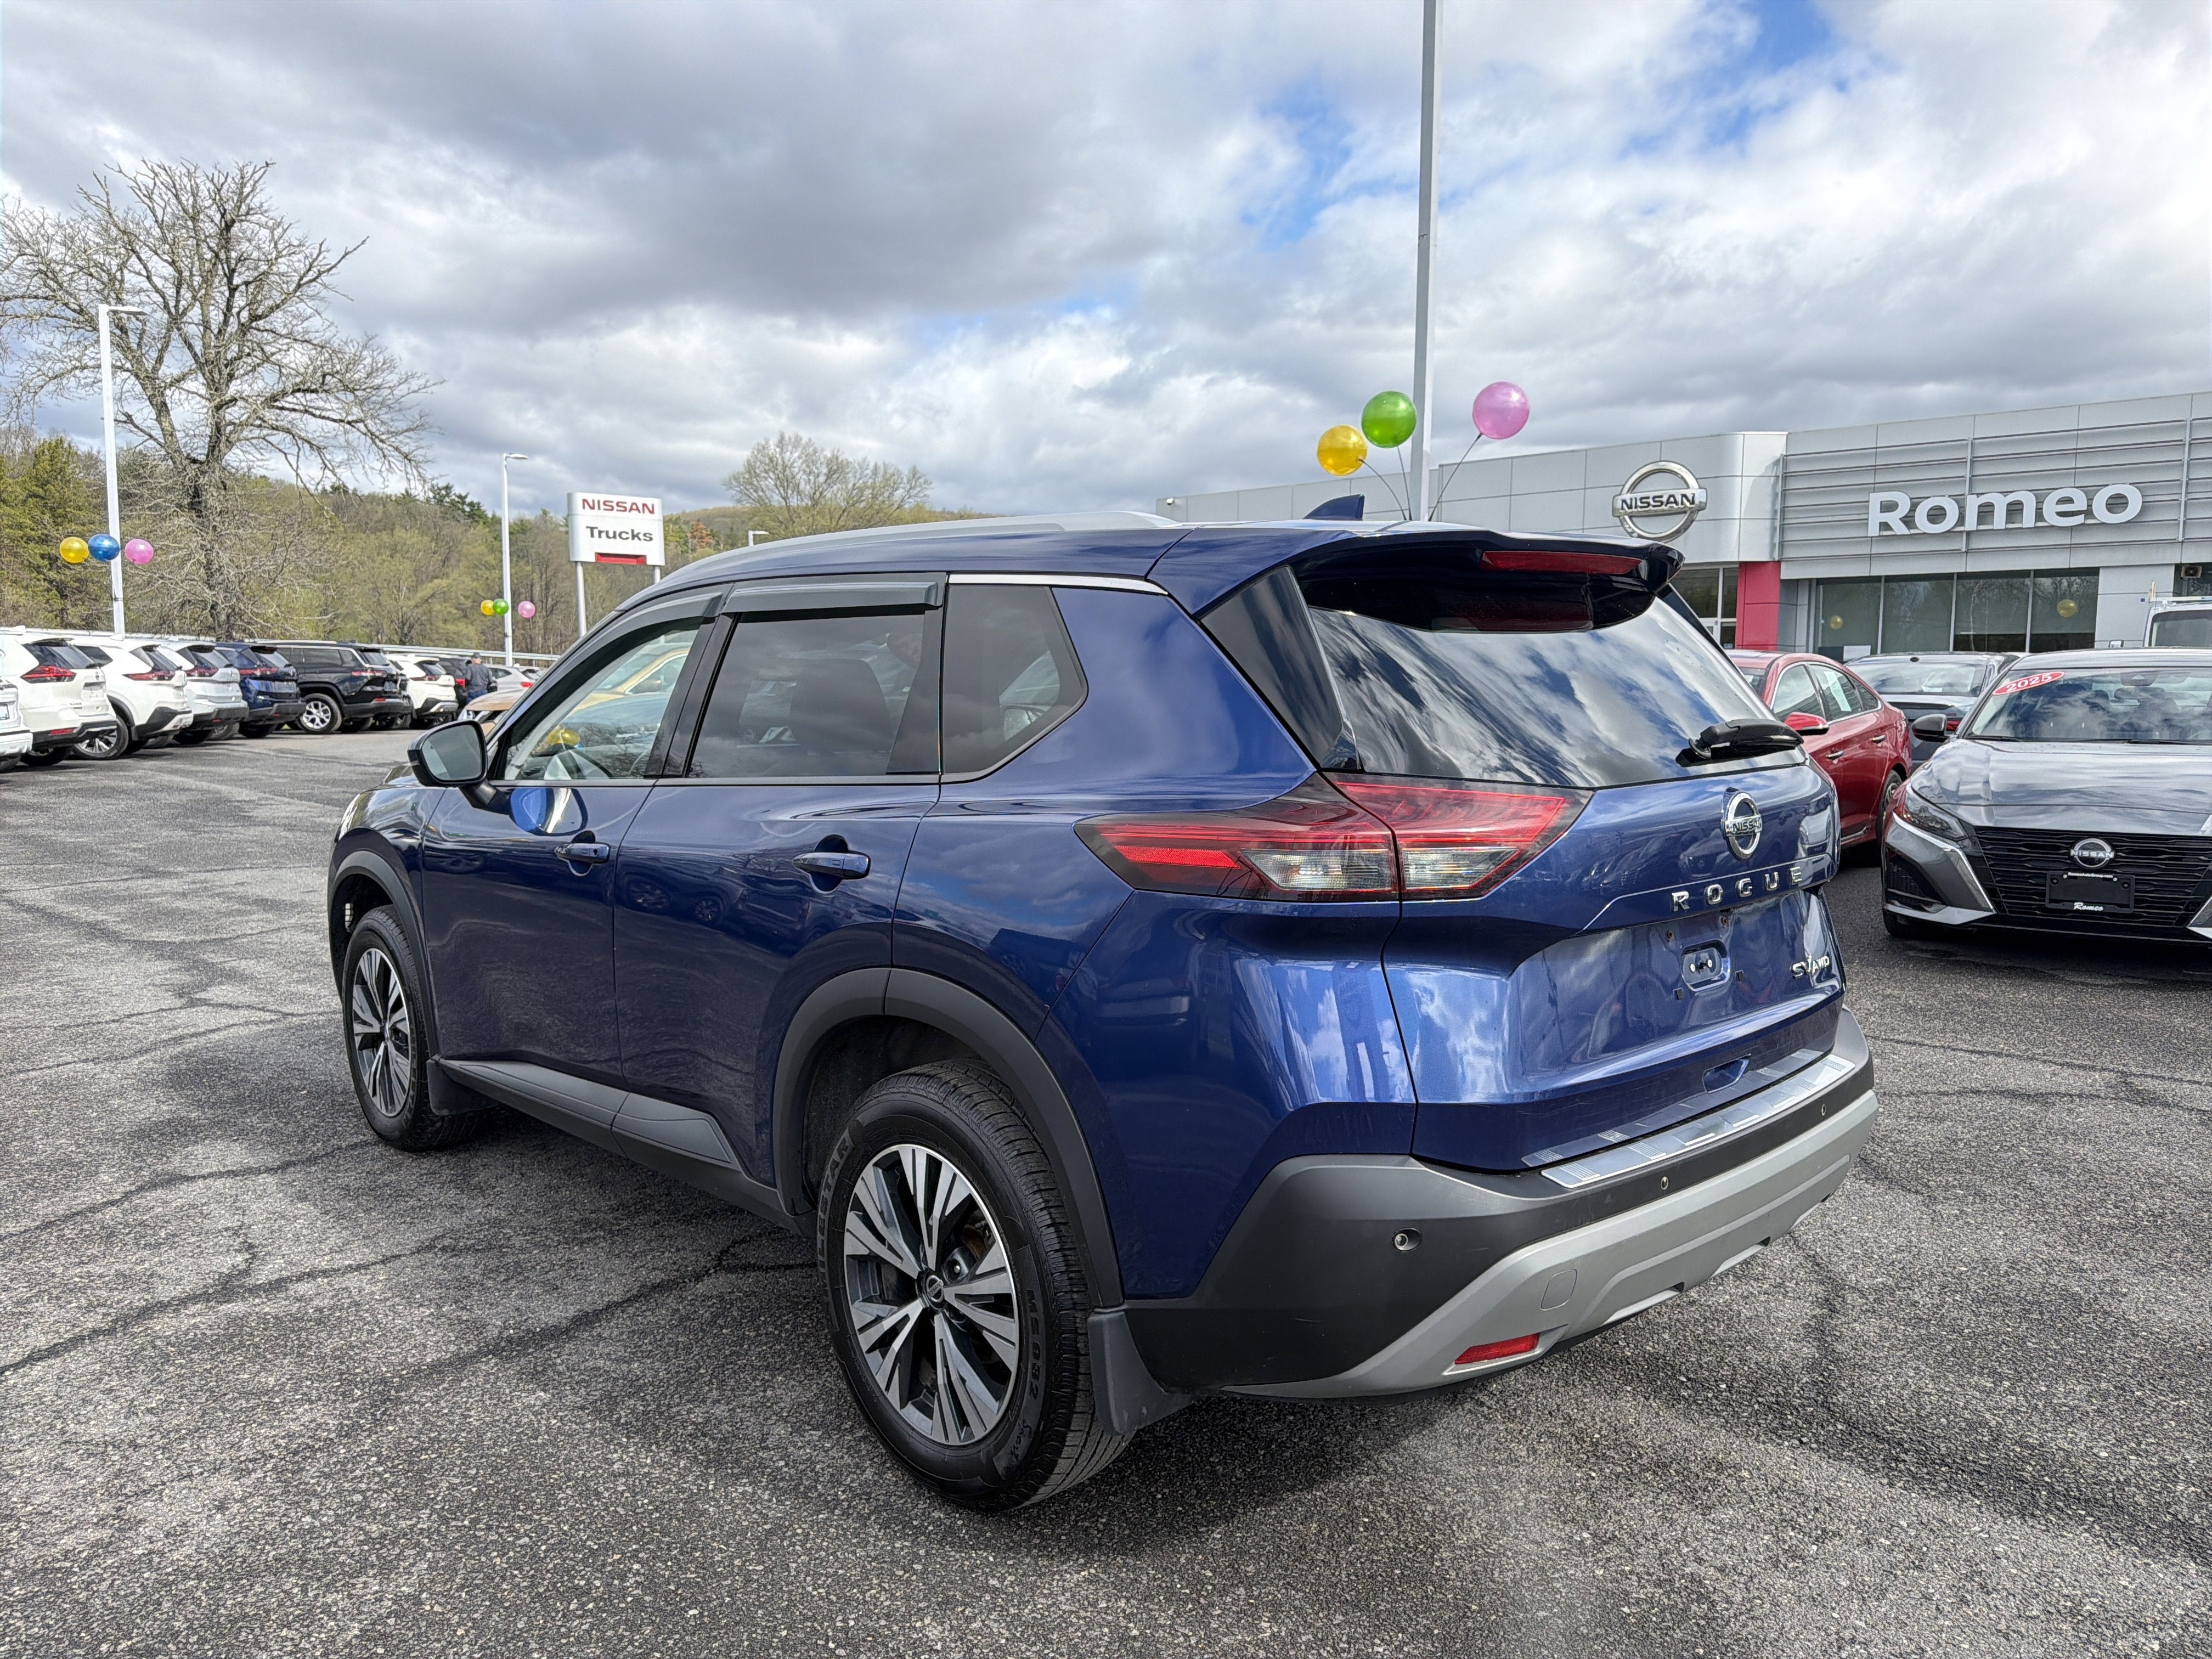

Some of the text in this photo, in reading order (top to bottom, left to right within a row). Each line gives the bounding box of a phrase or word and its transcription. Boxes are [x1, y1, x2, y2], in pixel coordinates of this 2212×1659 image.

[582, 498, 654, 514] NISSAN
[1621, 493, 1696, 510] NISSAN
[1867, 483, 2142, 537] Romeo
[585, 526, 653, 541] Trucks
[2006, 674, 2052, 692] 2025
[2070, 850, 2114, 859] NISSAN
[1671, 866, 1803, 912] ROGUE
[2073, 902, 2104, 911] Romeo
